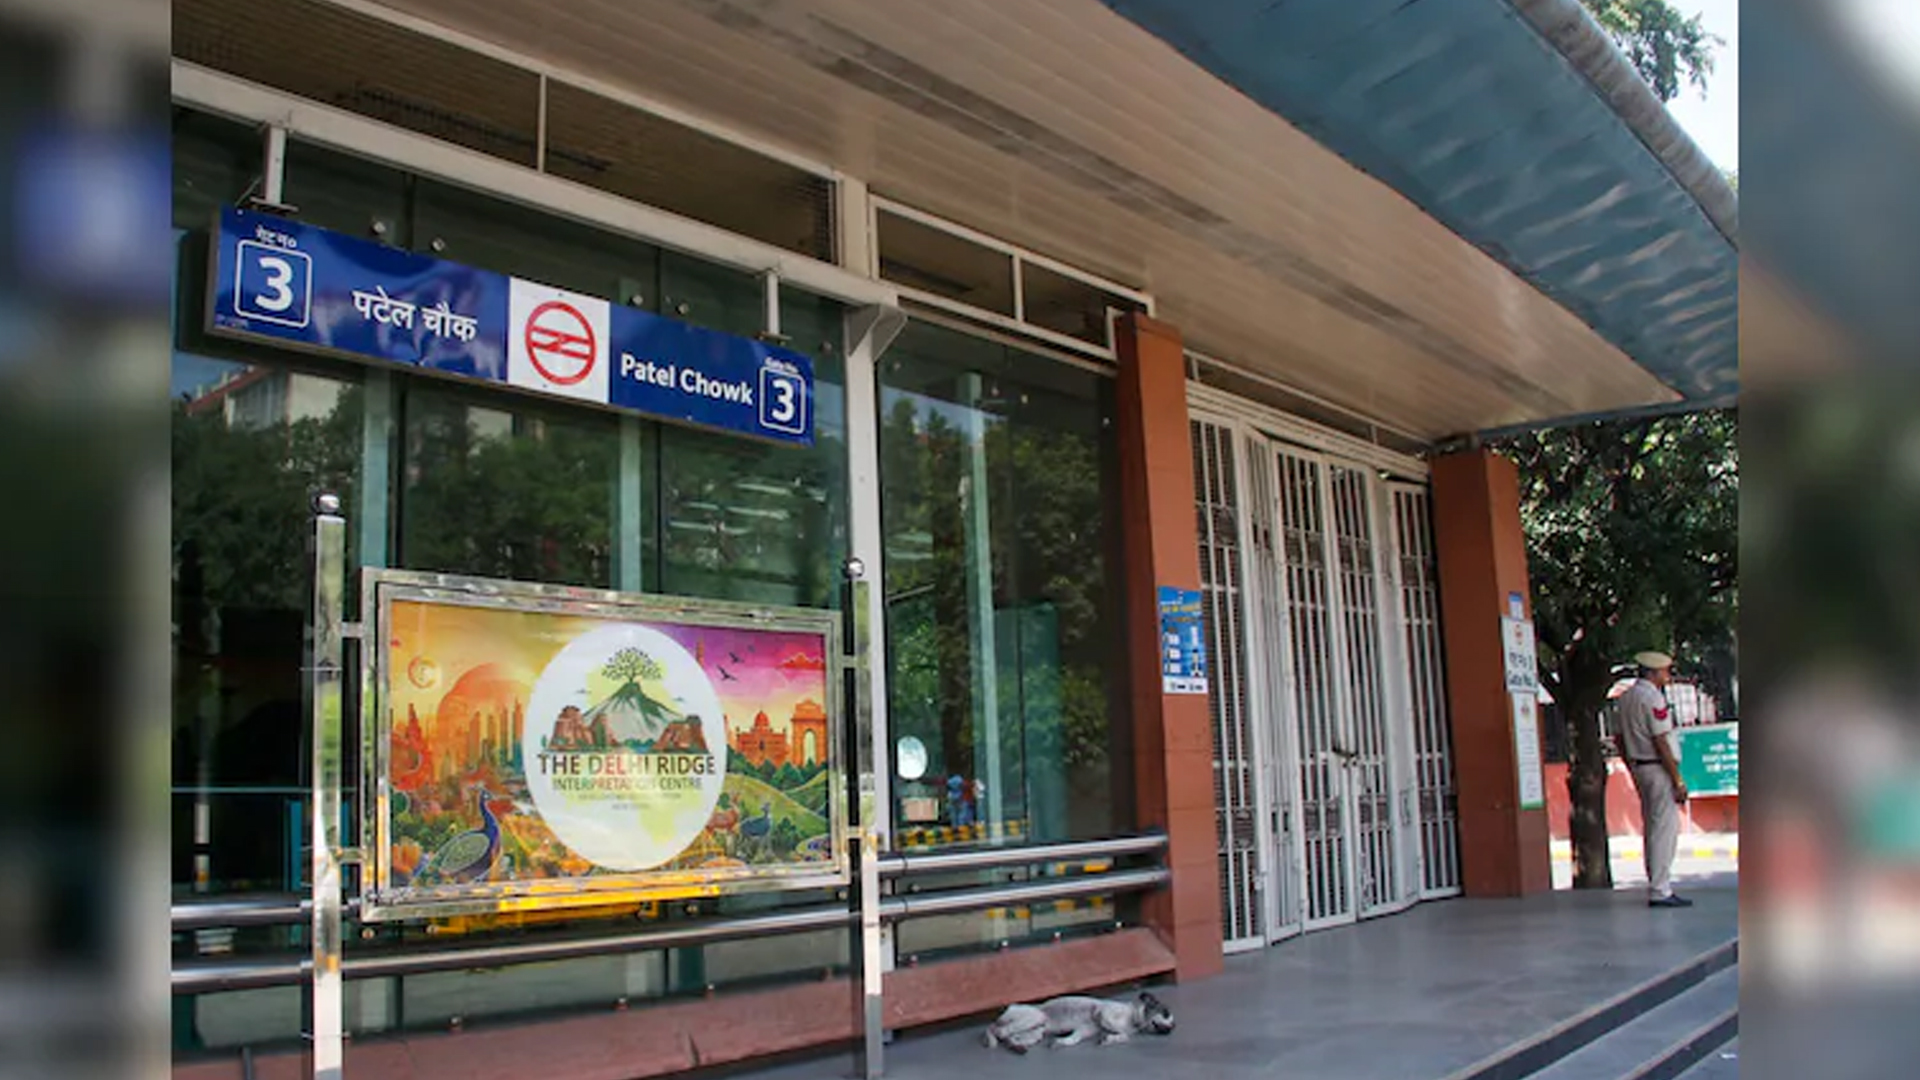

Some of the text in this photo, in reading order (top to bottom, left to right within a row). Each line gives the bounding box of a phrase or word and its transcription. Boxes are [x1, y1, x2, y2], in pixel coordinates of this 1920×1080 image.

[255, 257, 294, 312] 3
[351, 285, 478, 342] पटेल चौक
[620, 353, 753, 405] Patel Chowk
[772, 378, 796, 423] 3
[537, 754, 716, 775] THE DELHI RIDGE
[659, 778, 703, 791] CENTRE
